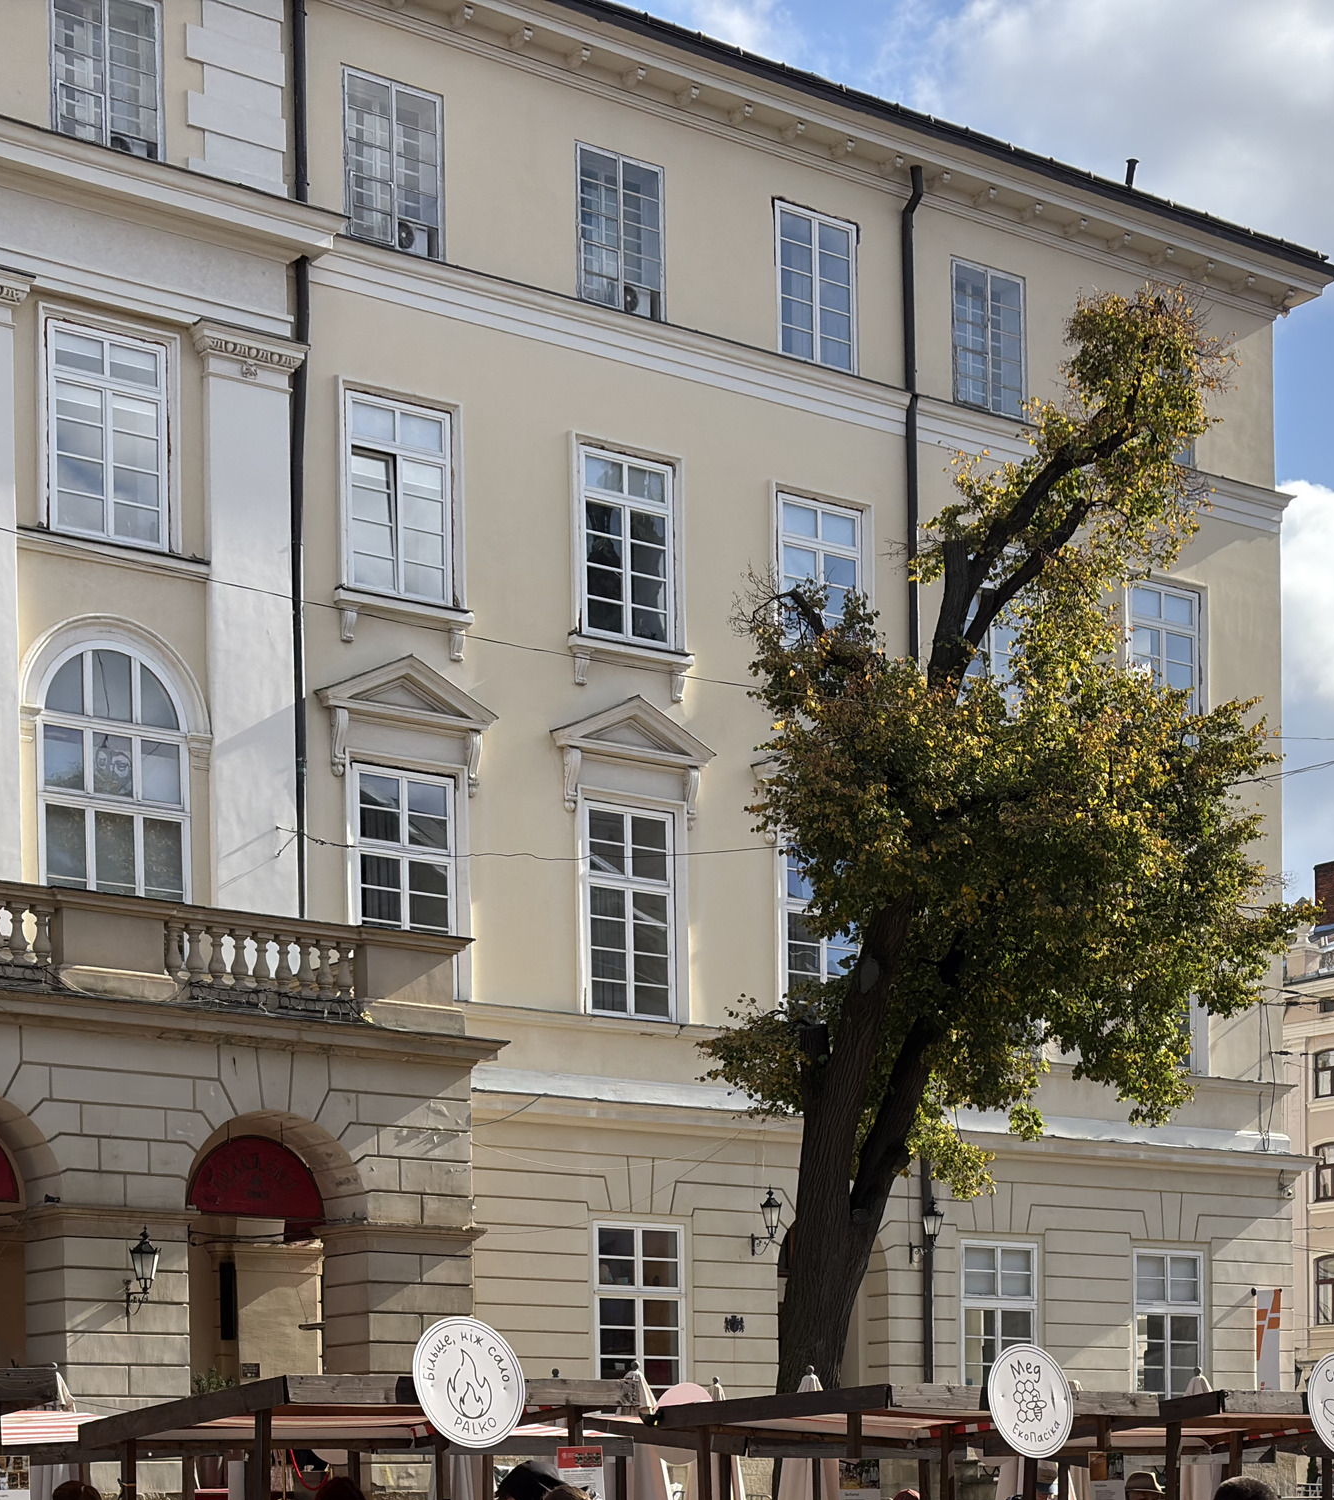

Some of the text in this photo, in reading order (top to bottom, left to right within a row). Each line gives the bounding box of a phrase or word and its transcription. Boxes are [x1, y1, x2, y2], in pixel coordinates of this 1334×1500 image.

[422, 1329, 510, 1383] Більше, ніж сало
[1009, 1359, 1041, 1384] Мед
[453, 1416, 497, 1435] PALKO
